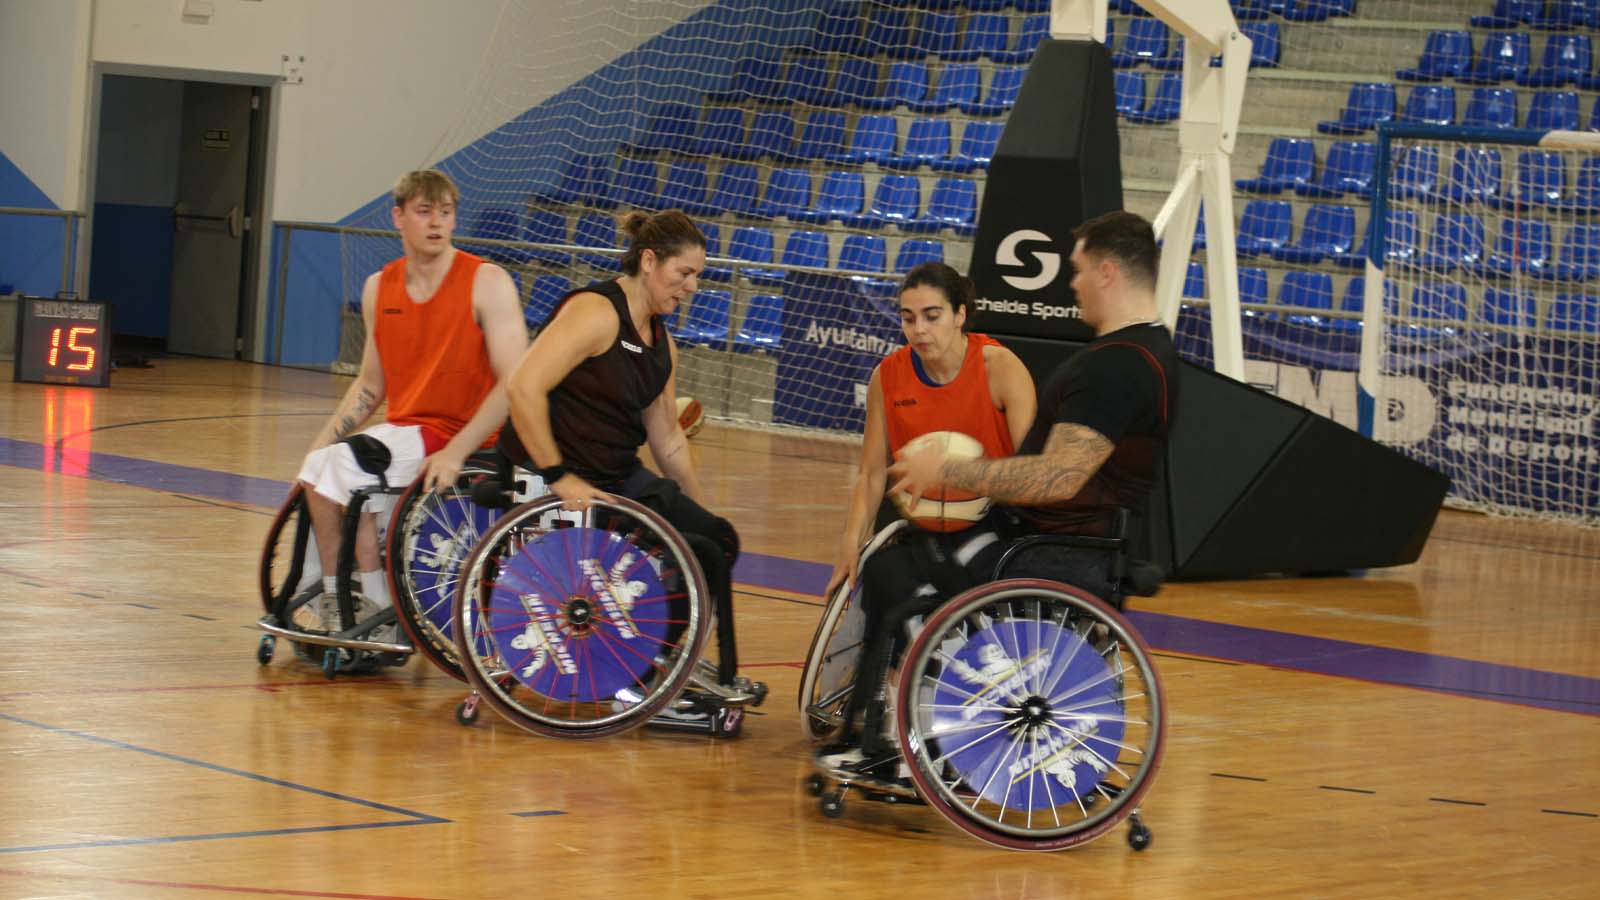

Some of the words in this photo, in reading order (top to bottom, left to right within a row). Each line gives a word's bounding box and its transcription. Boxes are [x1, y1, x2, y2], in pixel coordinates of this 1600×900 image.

[975, 297, 1028, 315] chelde
[48, 327, 96, 371] 15
[578, 559, 635, 639] MICHELIN
[523, 593, 578, 674] MICHELIN
